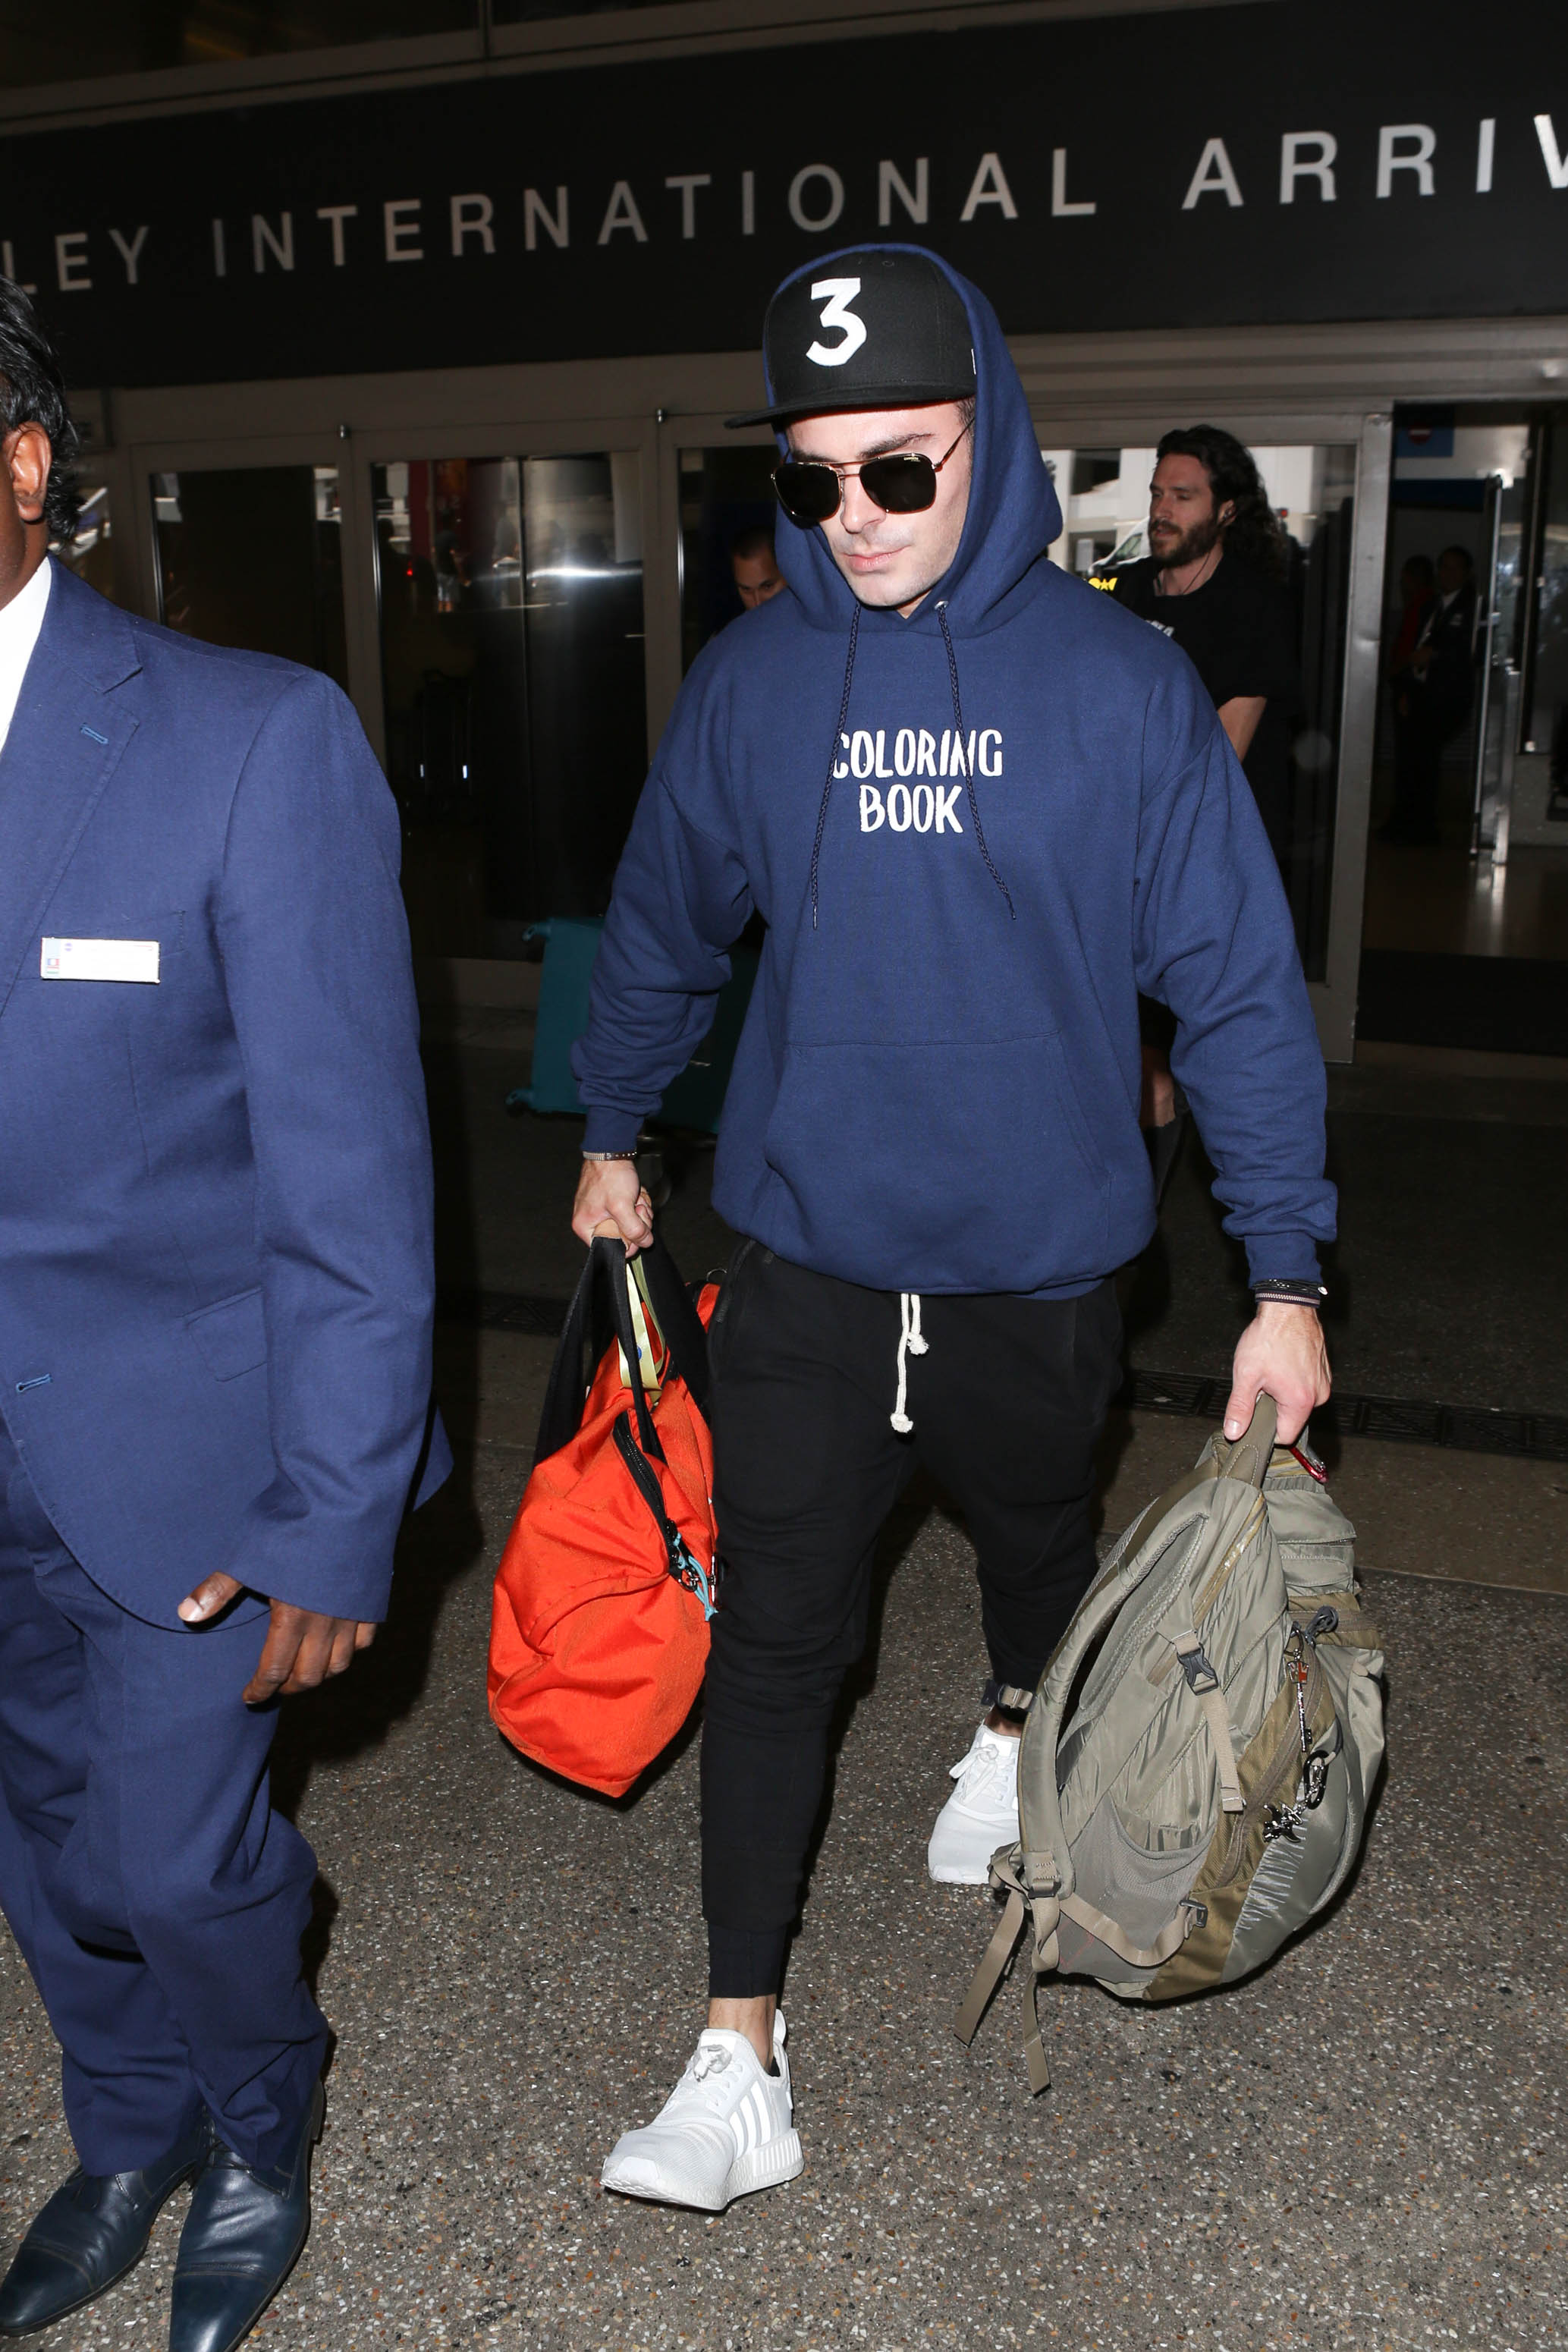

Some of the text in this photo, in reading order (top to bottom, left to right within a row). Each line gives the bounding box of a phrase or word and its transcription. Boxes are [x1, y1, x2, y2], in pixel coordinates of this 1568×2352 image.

[213, 146, 1098, 276] INTERNATIONAL
[806, 277, 867, 367] 3
[832, 728, 1003, 779] COLORING
[859, 784, 963, 834] BOOK
